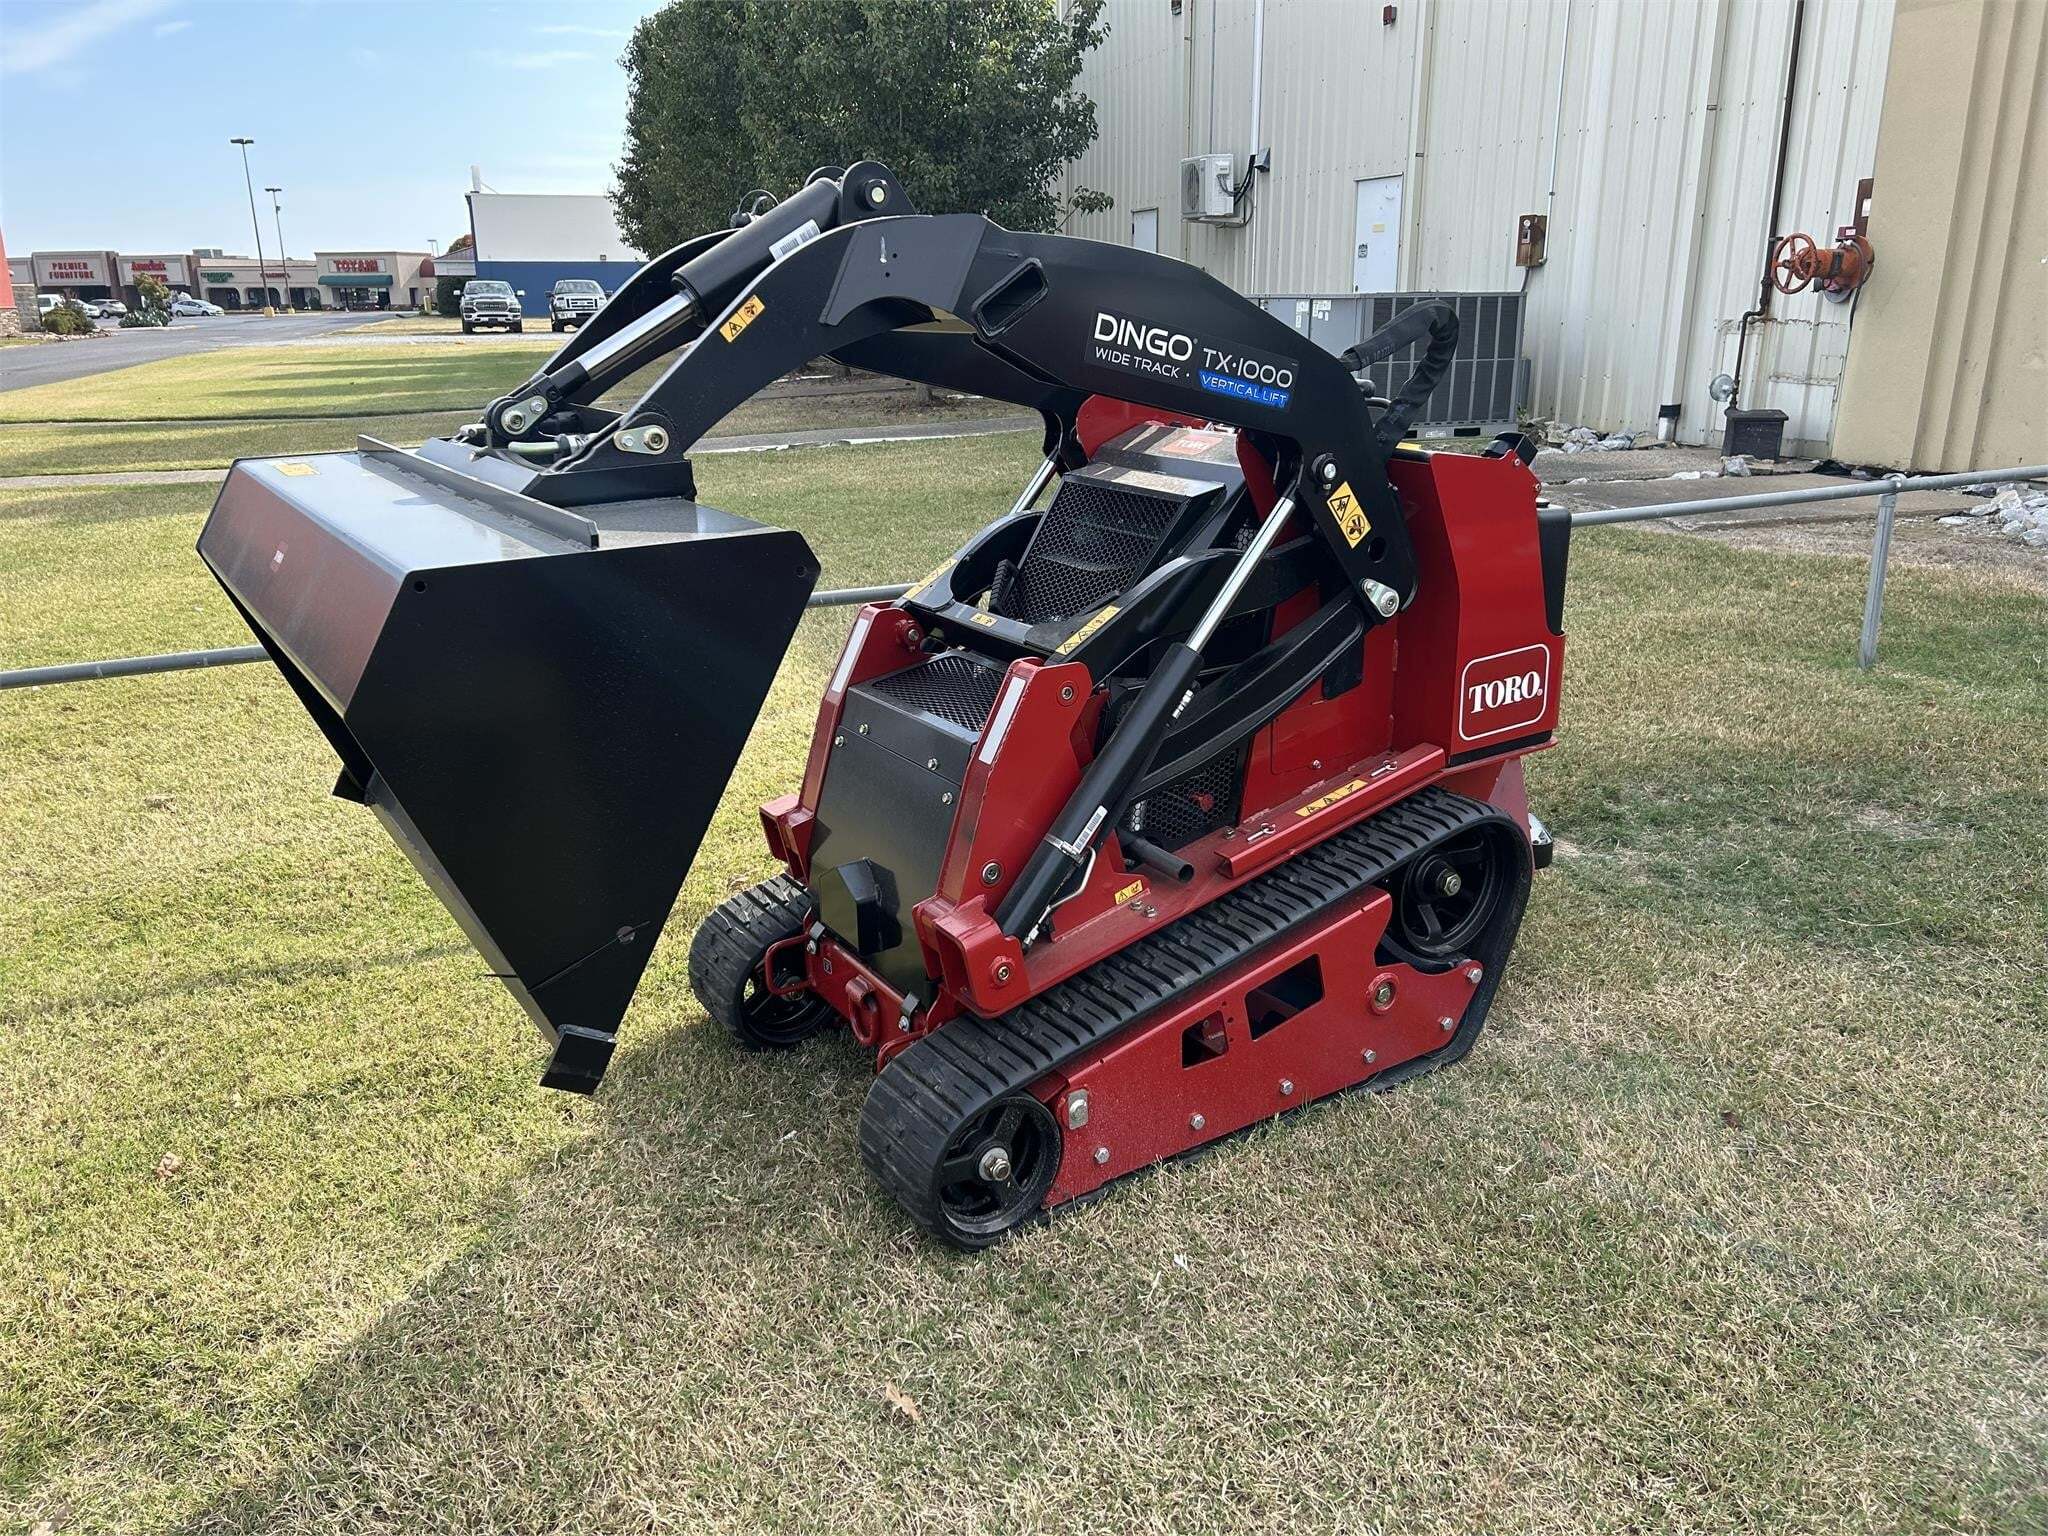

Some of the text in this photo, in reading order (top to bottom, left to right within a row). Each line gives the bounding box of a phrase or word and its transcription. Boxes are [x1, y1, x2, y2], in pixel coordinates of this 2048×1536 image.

[49, 271, 95, 279] FURNITURE
[52, 262, 89, 270] PREMIER
[1093, 312, 1193, 362] DINGO
[1095, 346, 1182, 379] WIDE TRACK
[1201, 374, 1288, 406] VERTICAL LIFT
[1468, 671, 1541, 714] TORO
